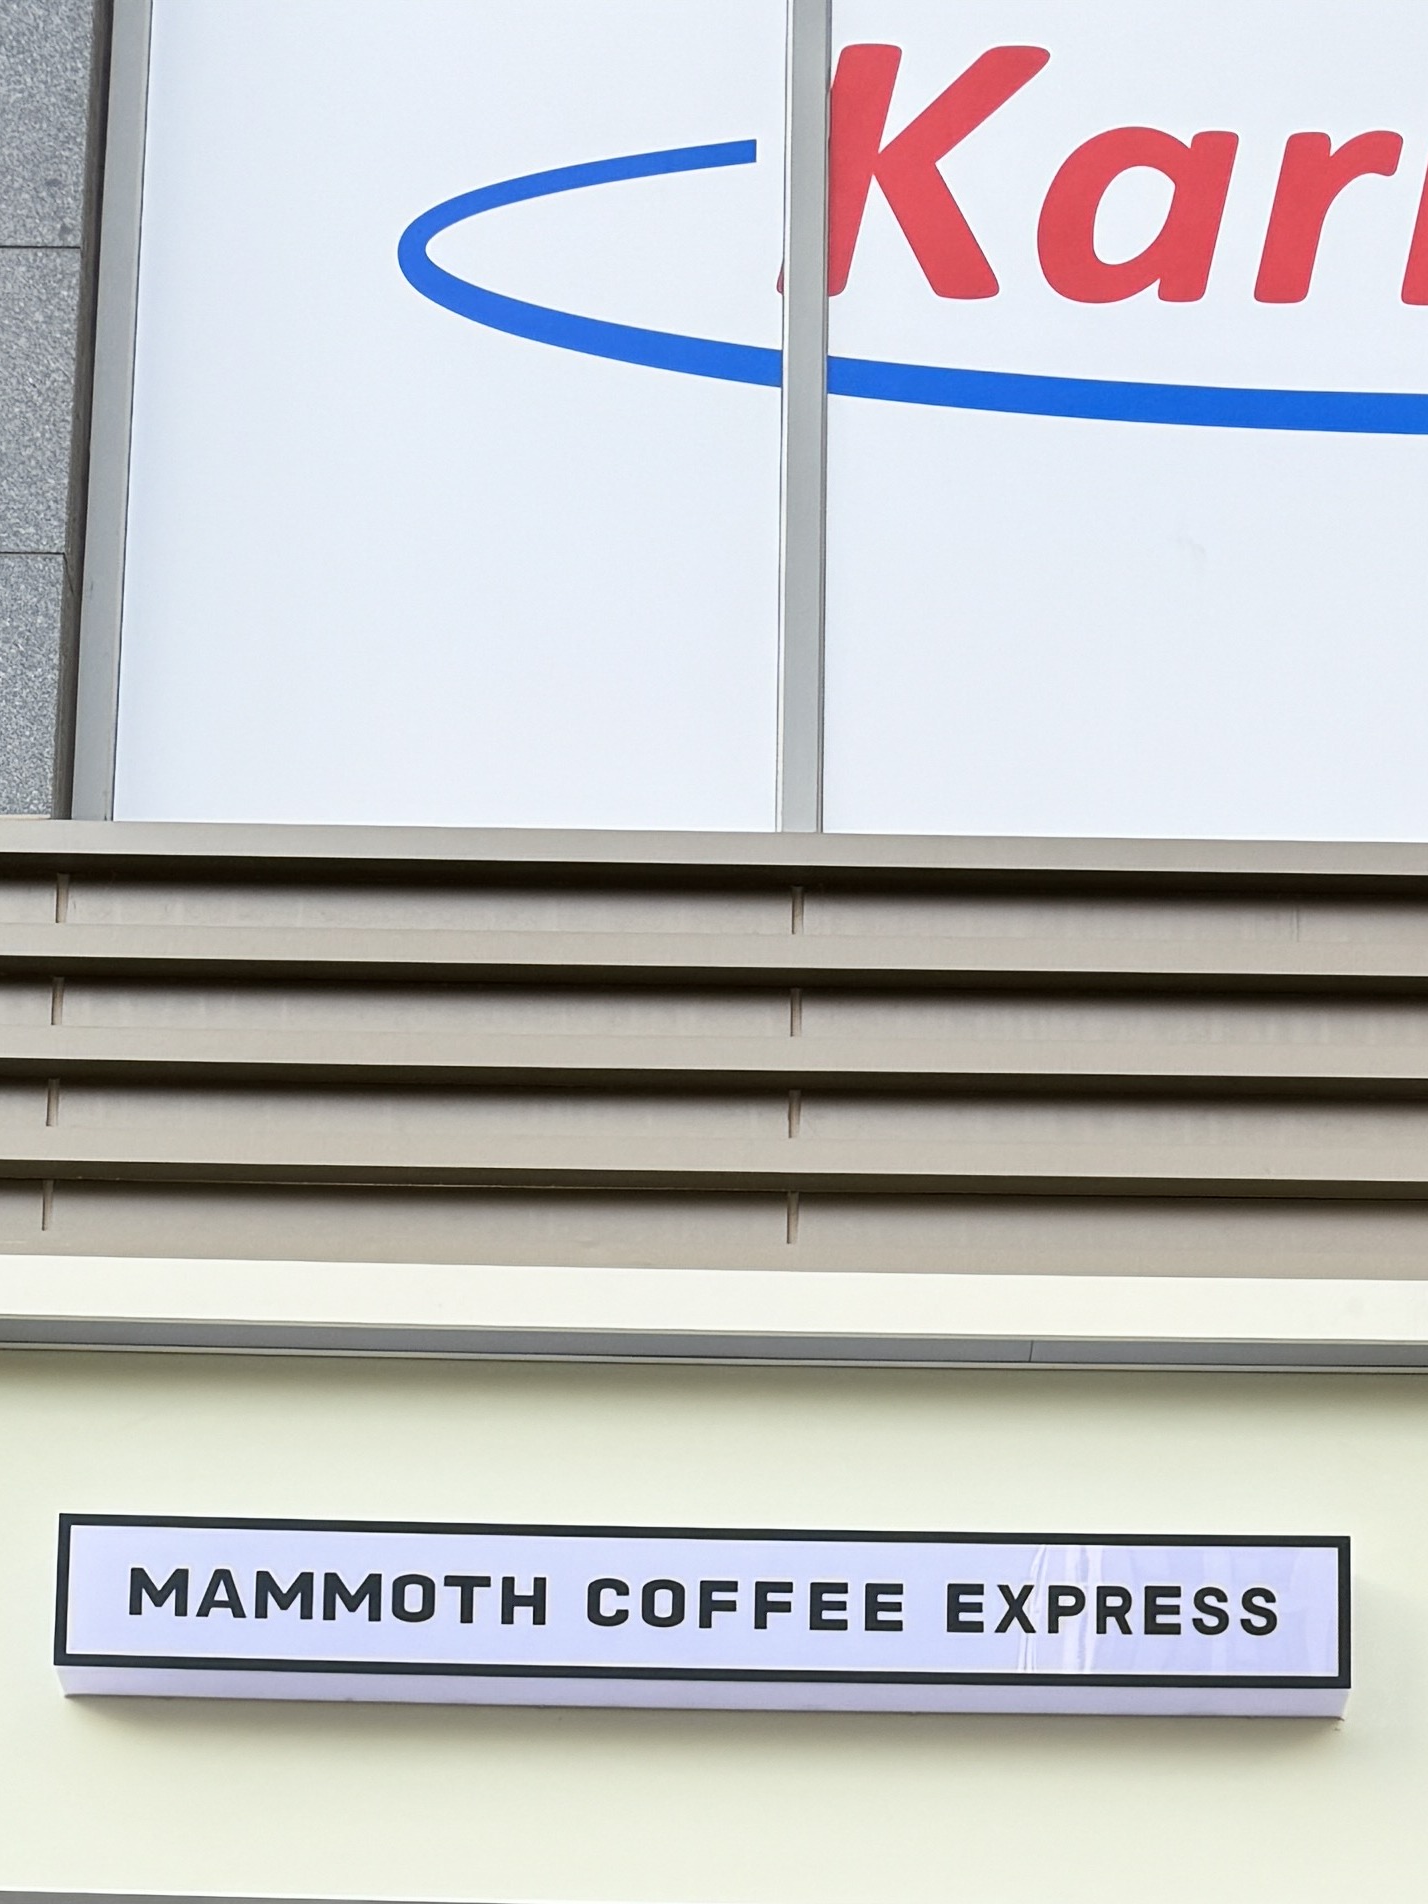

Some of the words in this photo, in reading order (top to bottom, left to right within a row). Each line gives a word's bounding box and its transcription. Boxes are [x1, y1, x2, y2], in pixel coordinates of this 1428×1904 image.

[127, 1565, 547, 1627] MAMMOTH
[586, 1576, 904, 1632] COFFEE
[944, 1582, 1280, 1636] EXPRESS
